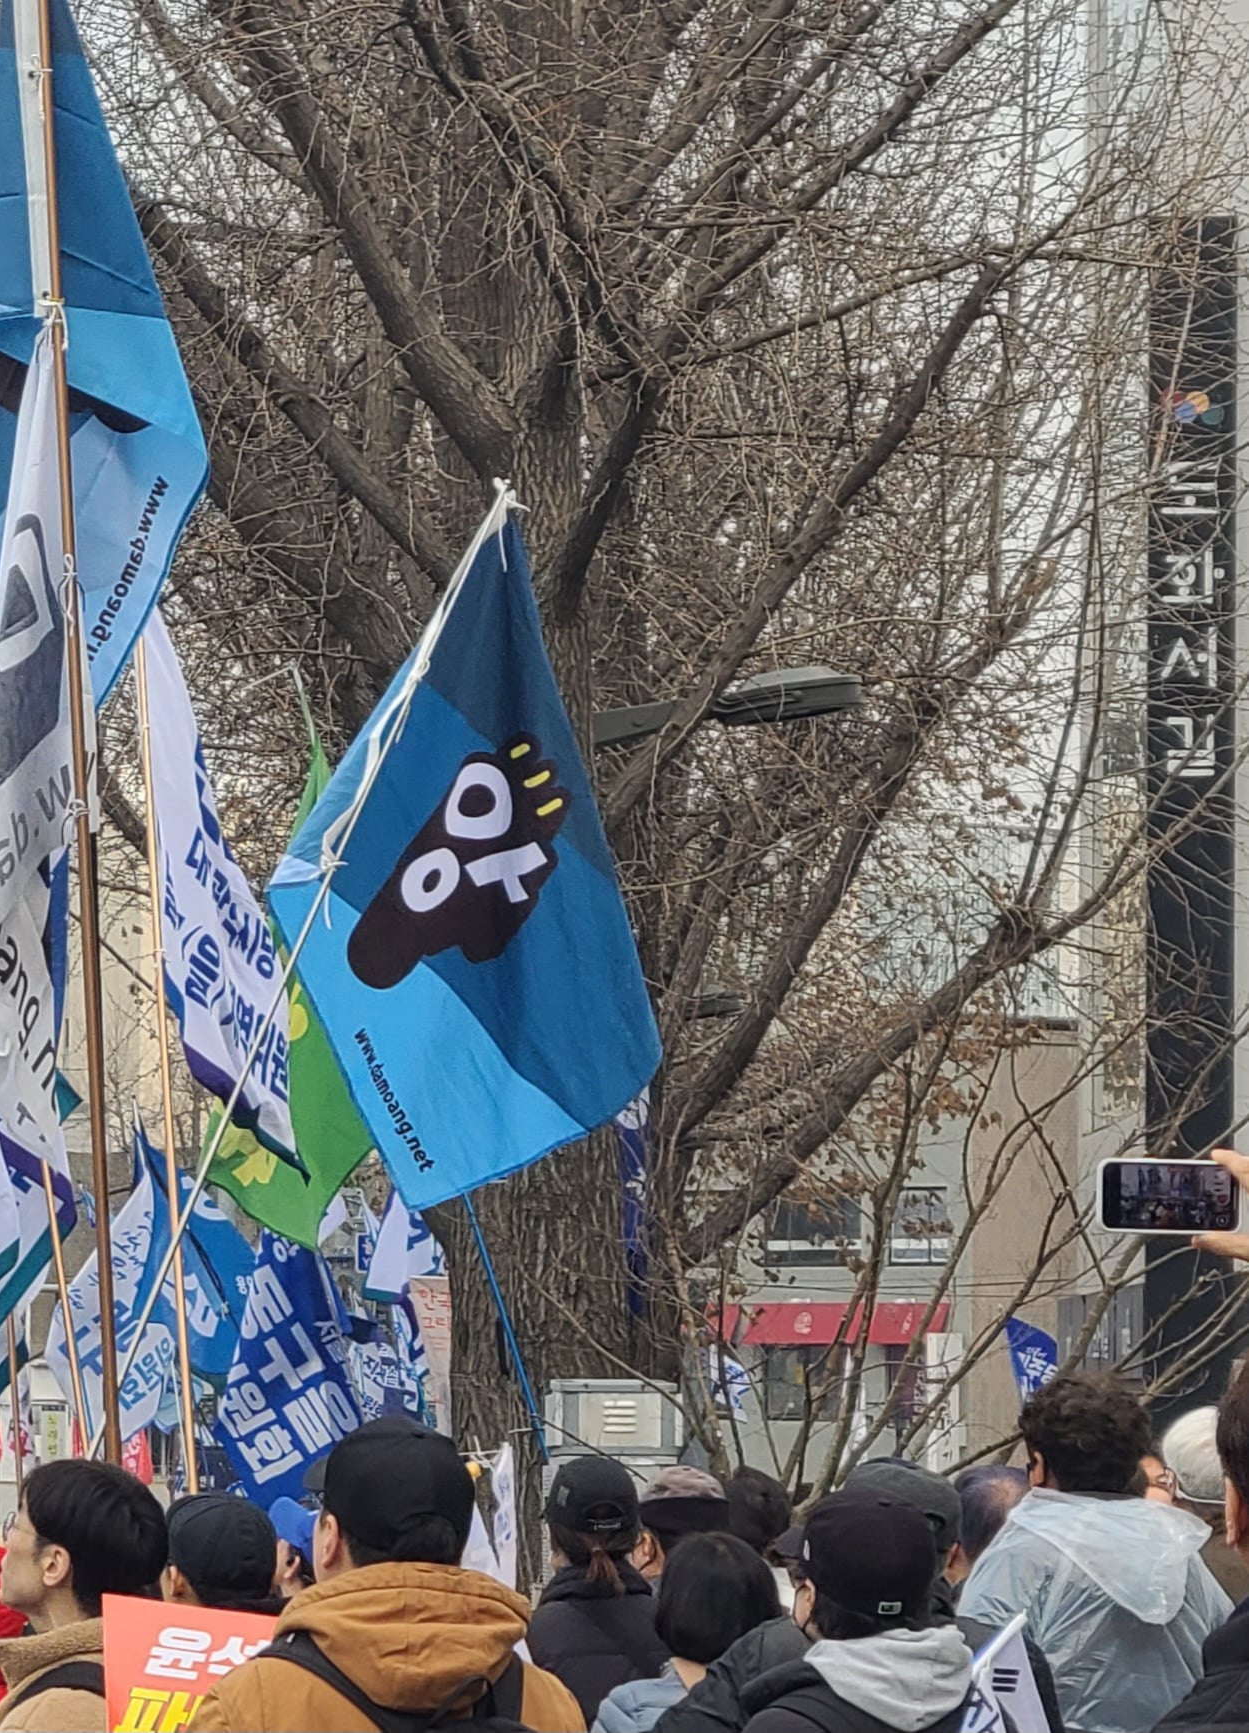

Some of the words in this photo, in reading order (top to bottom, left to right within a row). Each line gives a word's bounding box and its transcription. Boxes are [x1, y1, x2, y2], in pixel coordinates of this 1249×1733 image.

[354, 1028, 434, 1173] www.damoang.net
[241, 1263, 360, 1455] 동구을
[144, 1626, 272, 1680] 윤석
[114, 1687, 204, 1733] 파
